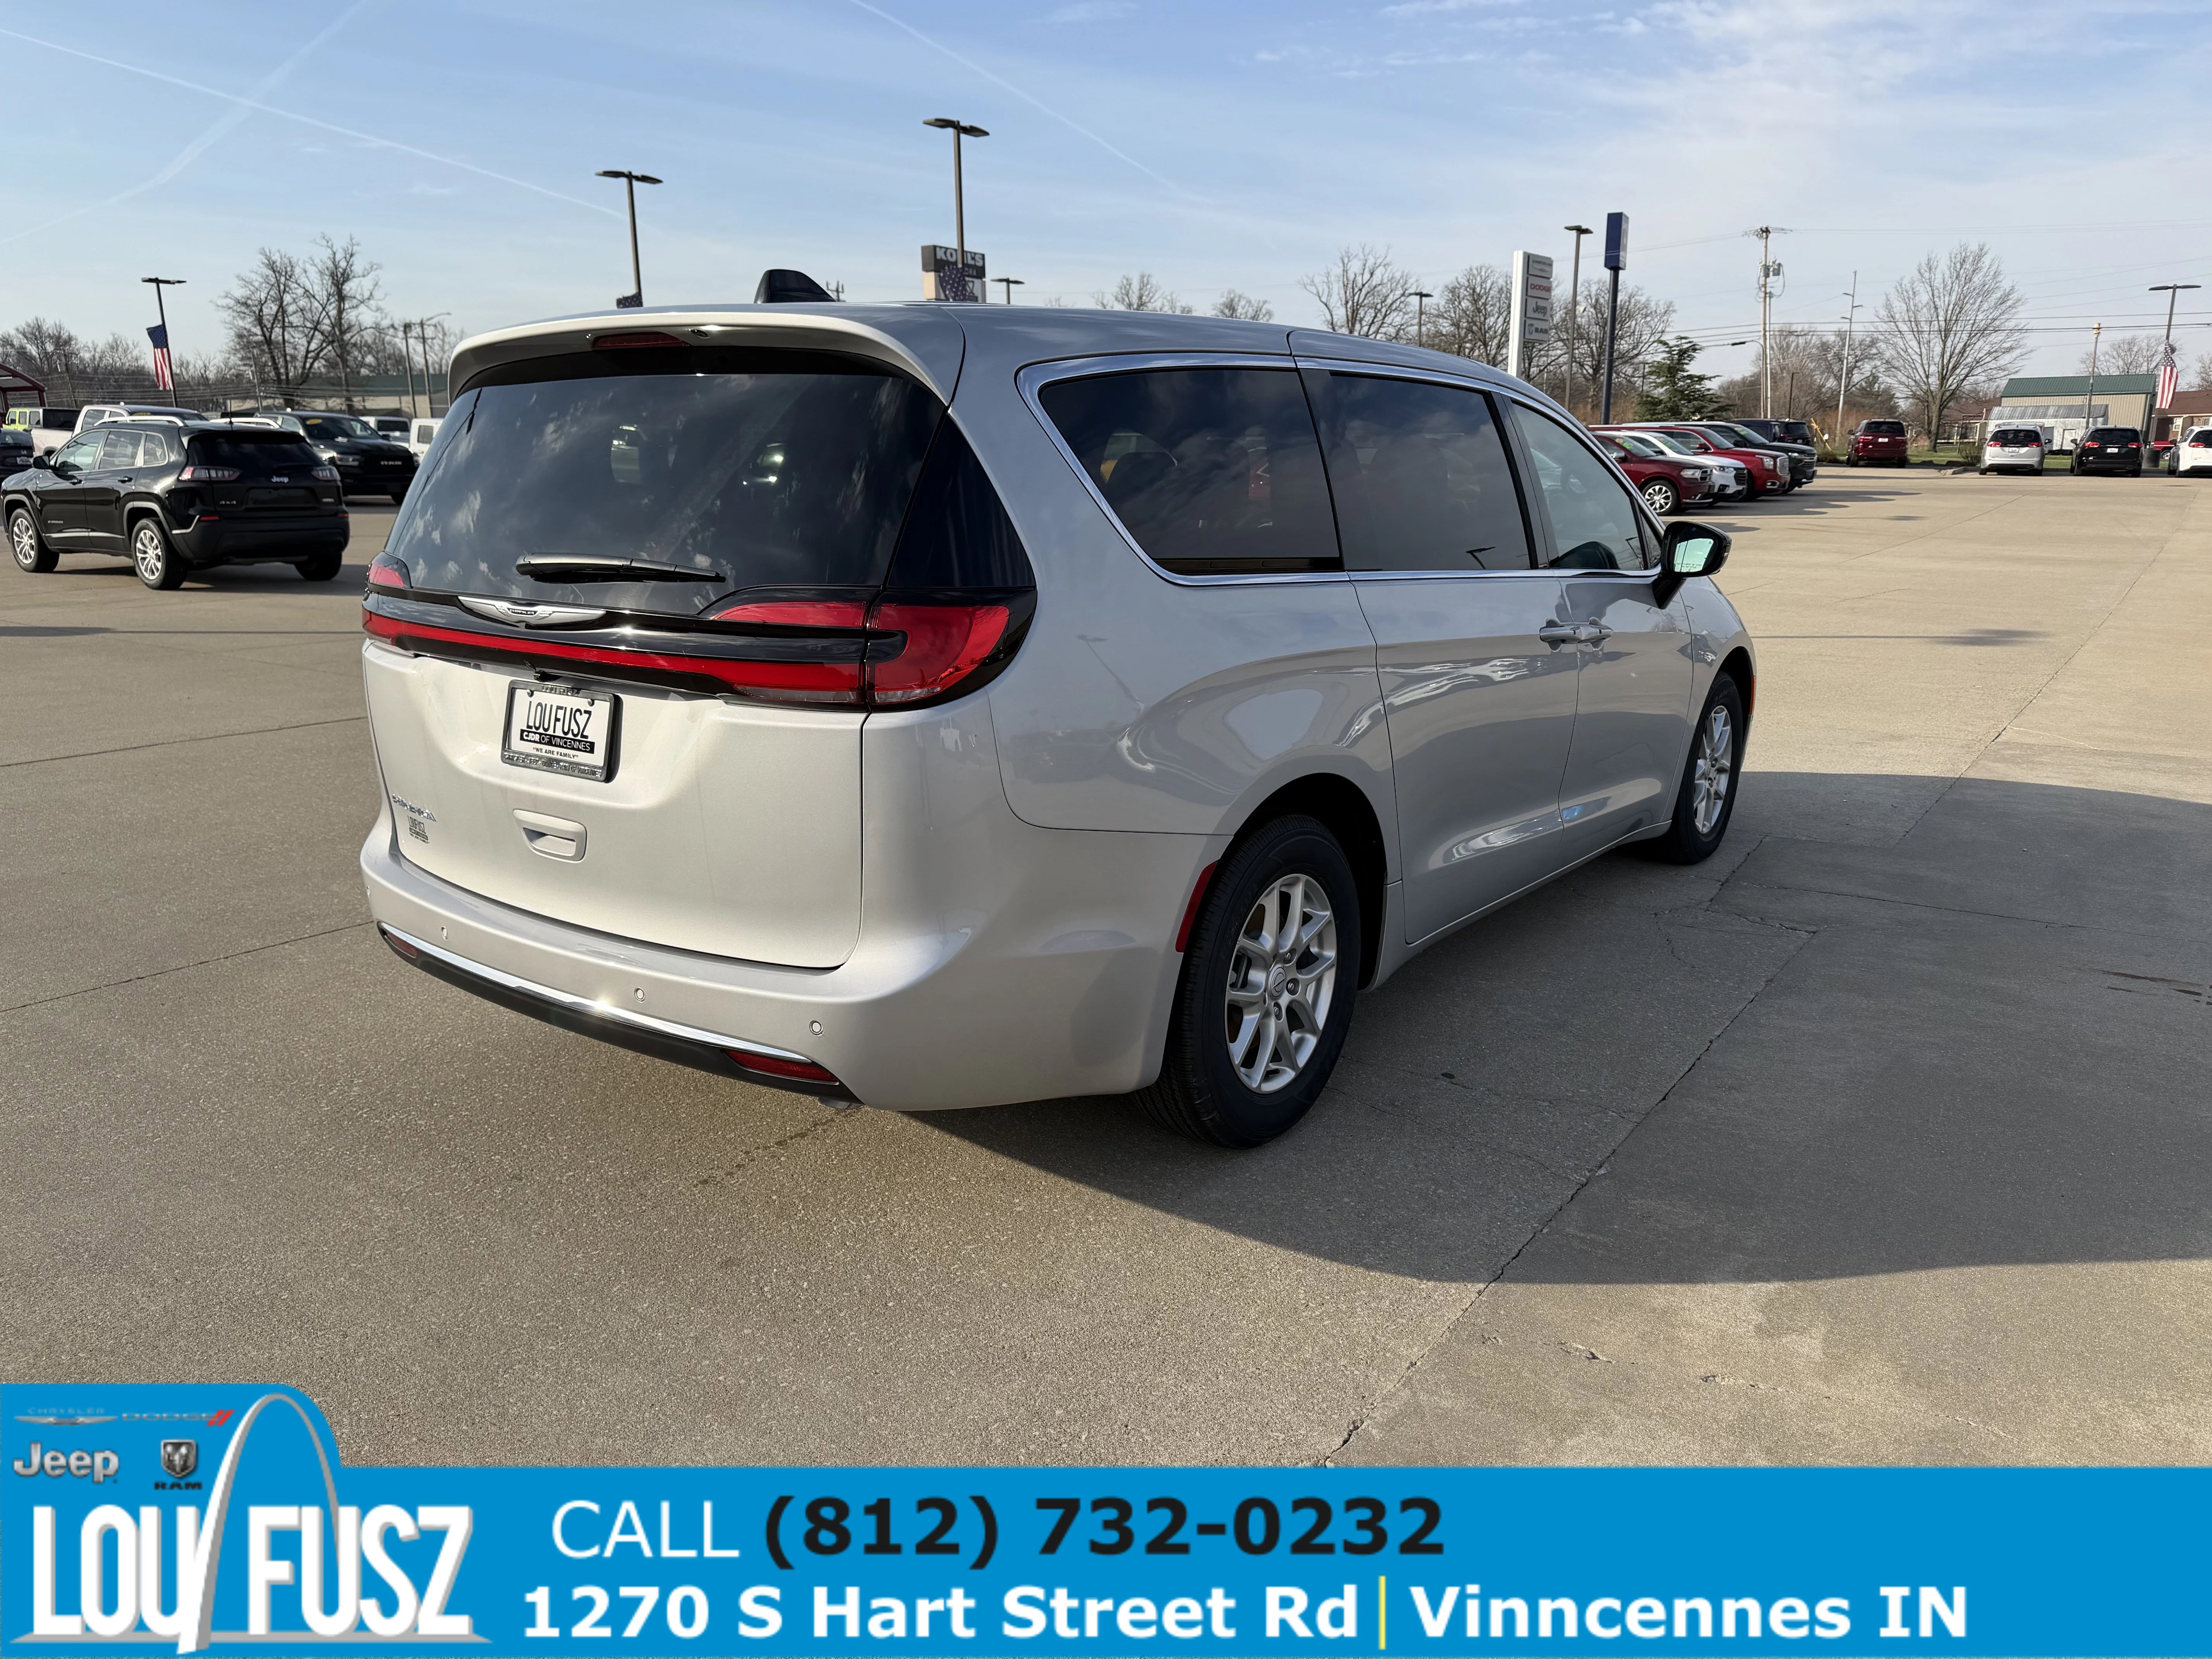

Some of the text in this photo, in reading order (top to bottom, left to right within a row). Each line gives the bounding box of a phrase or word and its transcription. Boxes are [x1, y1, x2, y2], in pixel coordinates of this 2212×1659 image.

[1533, 301, 1547, 317] Jeep
[526, 701, 592, 740] LOU FUSZ
[523, 732, 591, 751] CJDR OF VINCENNES
